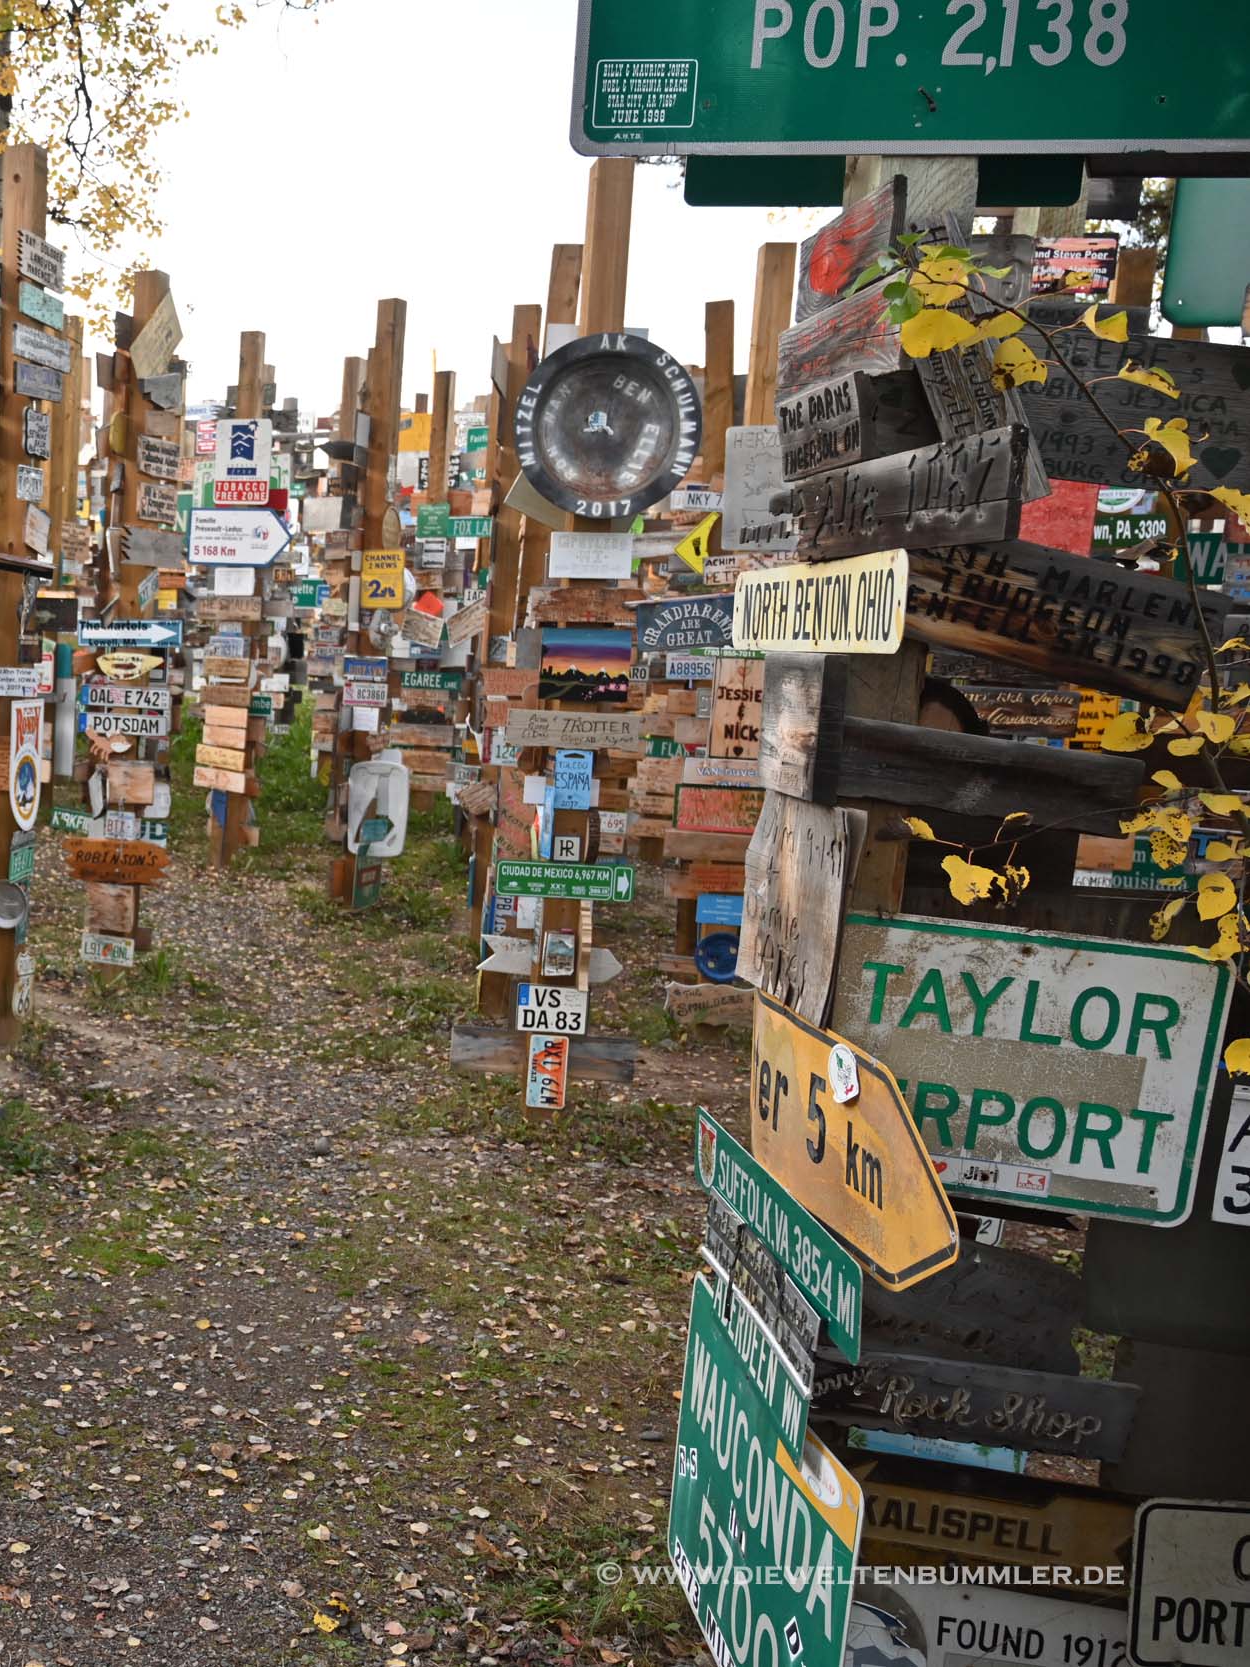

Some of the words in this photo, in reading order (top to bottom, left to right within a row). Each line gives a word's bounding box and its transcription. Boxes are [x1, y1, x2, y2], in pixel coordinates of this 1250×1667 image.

[750, 0, 906, 69] POP.
[941, 0, 1128, 75] 2,138
[603, 64, 623, 77] BILLY
[632, 64, 665, 77] MAURICE
[667, 64, 689, 77] JONES
[602, 80, 622, 92] NOEL
[630, 80, 661, 92] VIRGINIA
[664, 79, 688, 92] LEACH
[611, 110, 639, 123] JUNE
[1053, 250, 1082, 259] Steve
[613, 374, 652, 404] BEN
[516, 383, 541, 466] MITZEL
[656, 354, 697, 477] SCHULMANN
[780, 402, 804, 434] THE
[619, 424, 659, 485] ELLIE
[217, 482, 266, 491] TOBACCO
[216, 492, 239, 501] FREE
[242, 491, 266, 501] ZONE
[576, 500, 631, 516] 2017
[454, 522, 472, 535] FOX
[202, 546, 218, 557] 168
[221, 546, 236, 557] Km
[365, 554, 401, 562] CHANNEL
[743, 580, 789, 641] NORTH
[792, 574, 851, 640] BENTON,
[855, 568, 895, 642] OHIO
[680, 618, 701, 630] ARE
[666, 630, 713, 647] GREAT
[135, 691, 160, 707] 742
[717, 686, 763, 703] JESSIE
[93, 716, 159, 734] POTSDAM
[561, 718, 630, 734] TROTTER
[724, 724, 760, 742] NICK
[555, 771, 591, 791] ESPAÑA
[502, 864, 531, 876] CIUDAD
[532, 865, 542, 877] DE
[544, 867, 573, 878] MEXICO
[597, 870, 610, 881] KM
[535, 989, 562, 1008] VS
[522, 1009, 549, 1030] DA
[555, 1010, 581, 1031] 83
[862, 961, 1181, 1061] TAYLOR
[806, 1072, 827, 1164] 5
[846, 1121, 883, 1211] km
[792, 1225, 832, 1311] 3854
[837, 1272, 857, 1339] MI
[877, 1372, 976, 1427] Rock
[985, 1393, 1103, 1445] Shop
[691, 1332, 833, 1641] WAUCONDA
[863, 1496, 1062, 1557] KALISPELL
[936, 1615, 1045, 1661] FOUND
